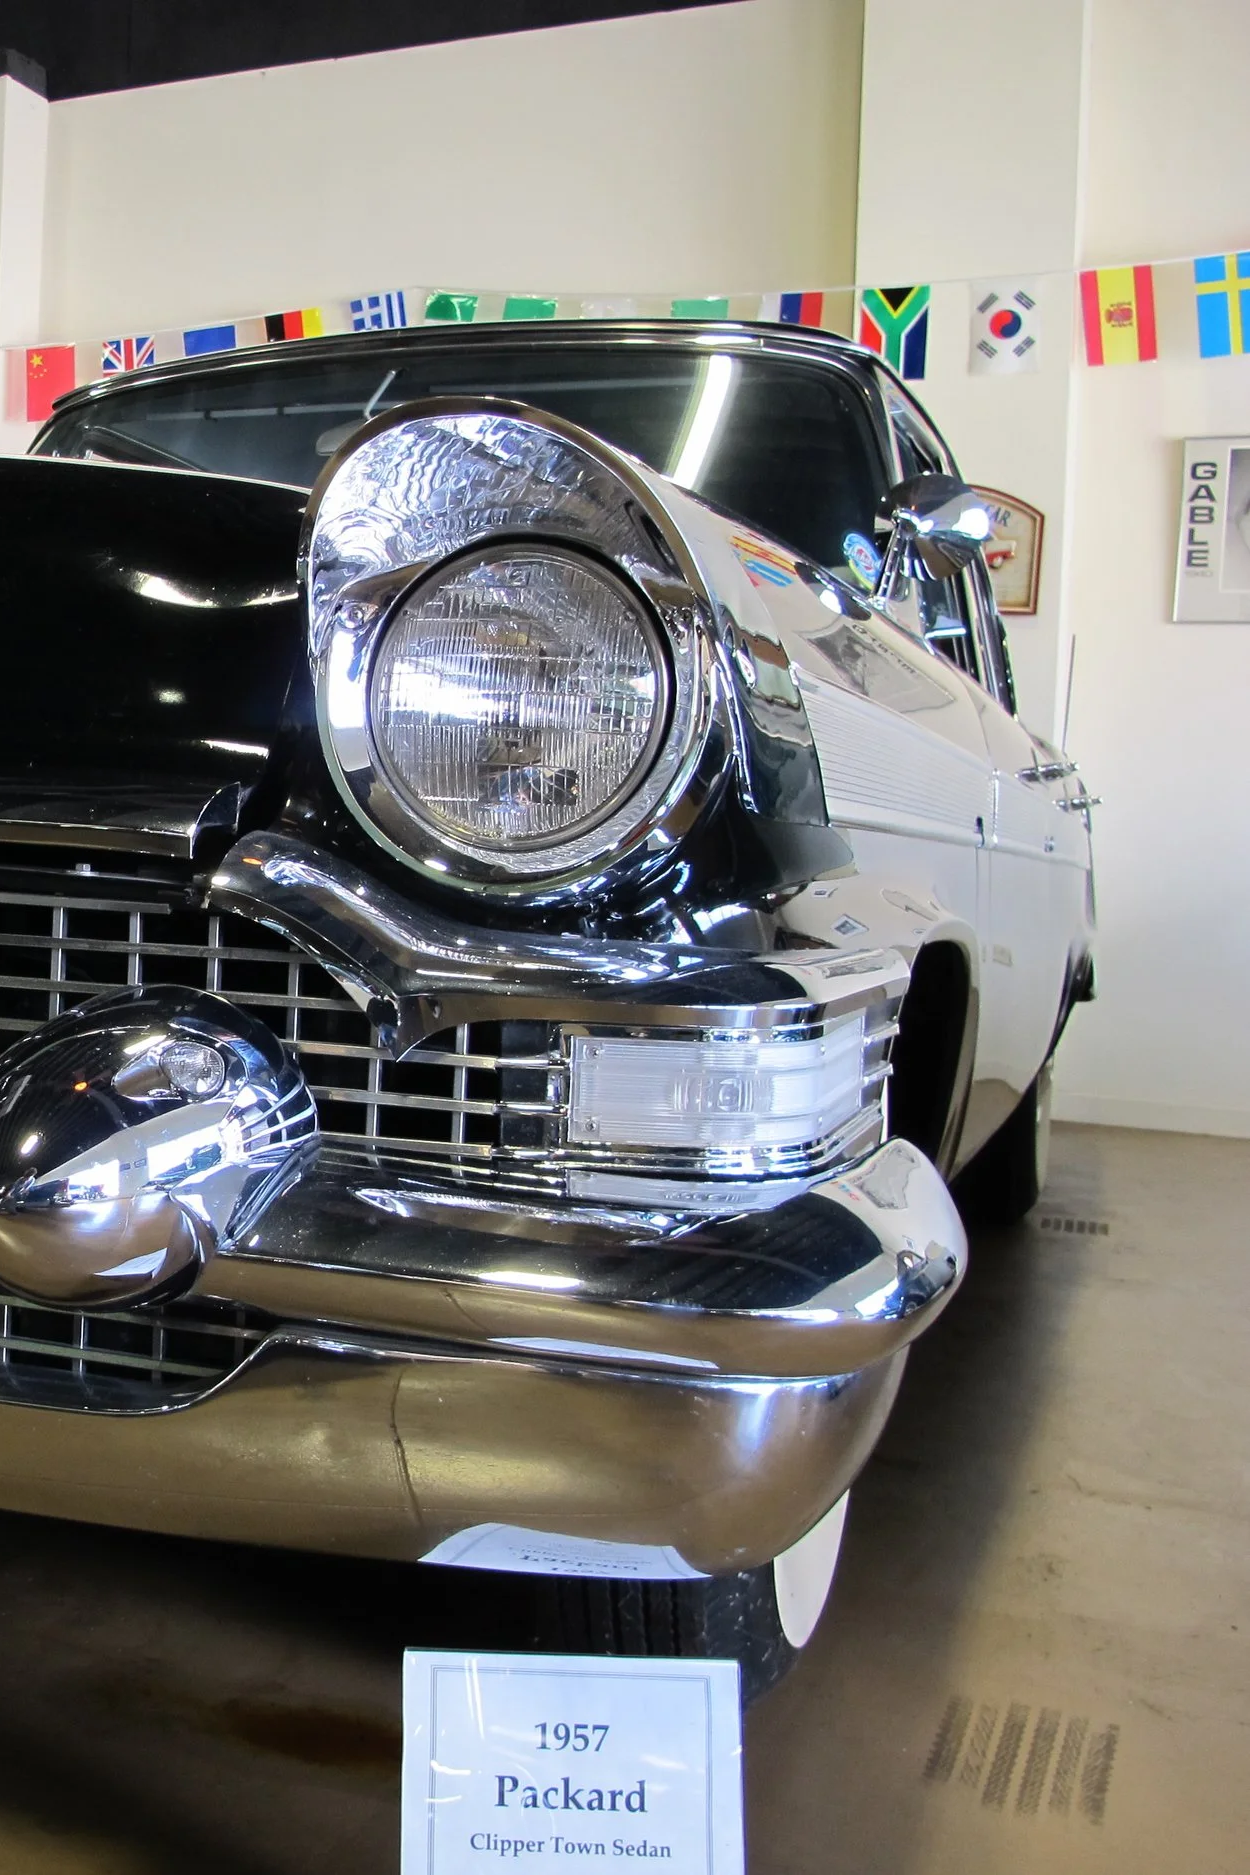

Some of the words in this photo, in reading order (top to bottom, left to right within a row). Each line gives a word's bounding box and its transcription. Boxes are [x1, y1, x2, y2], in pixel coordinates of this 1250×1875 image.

[1186, 462, 1217, 567] GABLE
[535, 1722, 610, 1752] 1957
[494, 1775, 648, 1813] Packard
[470, 1833, 545, 1857] Clipper
[550, 1836, 606, 1856] Town
[612, 1838, 672, 1858] Sedan
